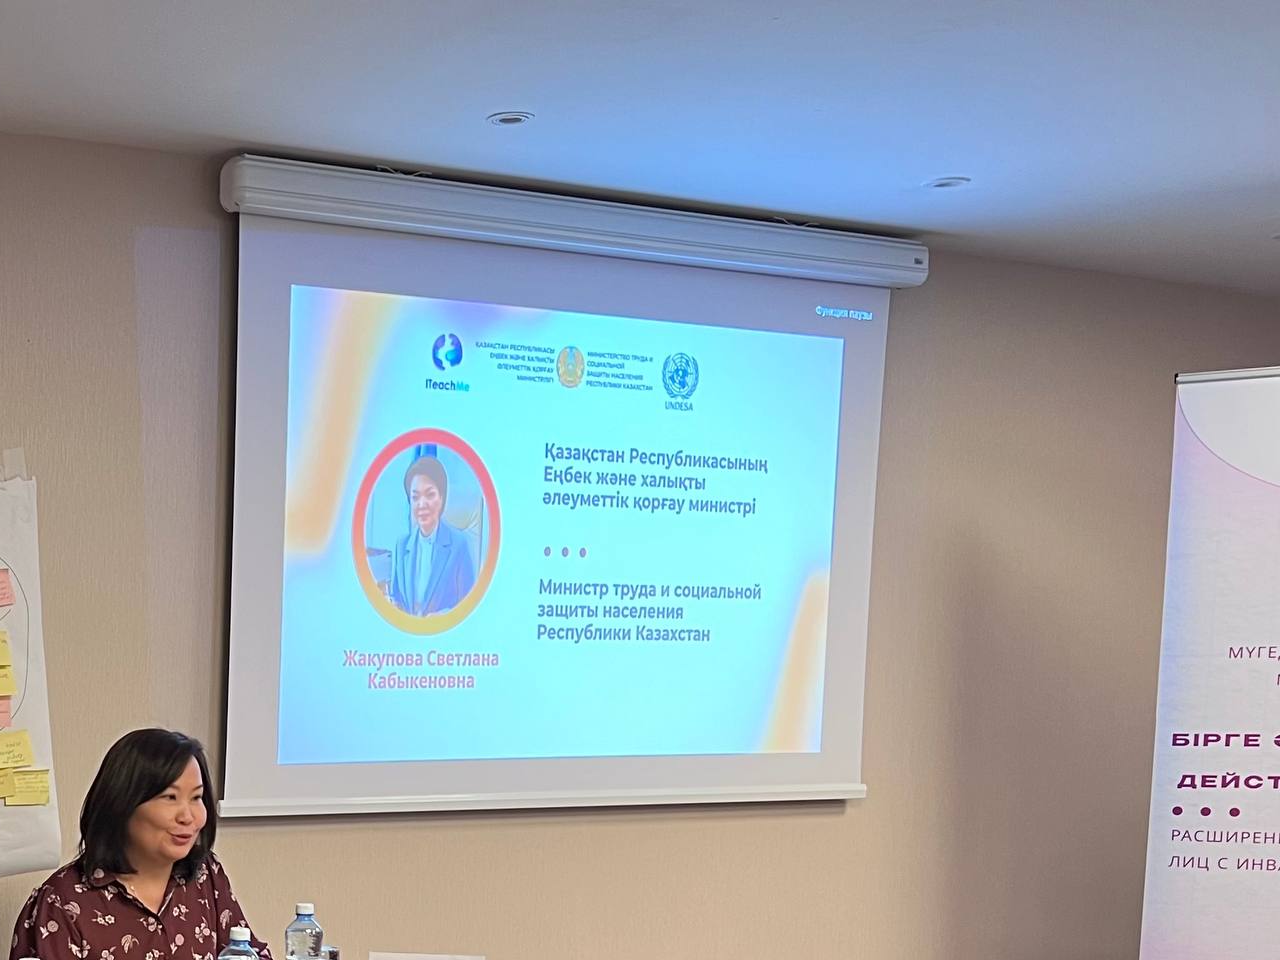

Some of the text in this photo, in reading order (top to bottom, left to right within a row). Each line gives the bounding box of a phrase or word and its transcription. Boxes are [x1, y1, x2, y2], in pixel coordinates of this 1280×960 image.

[425, 378, 470, 393] ITeachMe
[544, 442, 769, 475] Қазақстан Республикасының
[543, 466, 706, 491] Еңбек және халықты
[542, 490, 757, 518] әлеуметтік қорғау министрі
[539, 578, 762, 601] Министр труда и социальной
[537, 604, 684, 620] защиты населения
[536, 623, 711, 644] Республики Казахстан
[342, 649, 499, 672] Жакупова Светлана
[1228, 646, 1280, 660] МҮГЕ
[367, 671, 475, 690] Кабыкеновна
[1171, 733, 1261, 747] БІРГЕ
[1171, 829, 1280, 844] РАСШИРЕН
[1168, 855, 1280, 872] ЛИЦ С ИНВ
